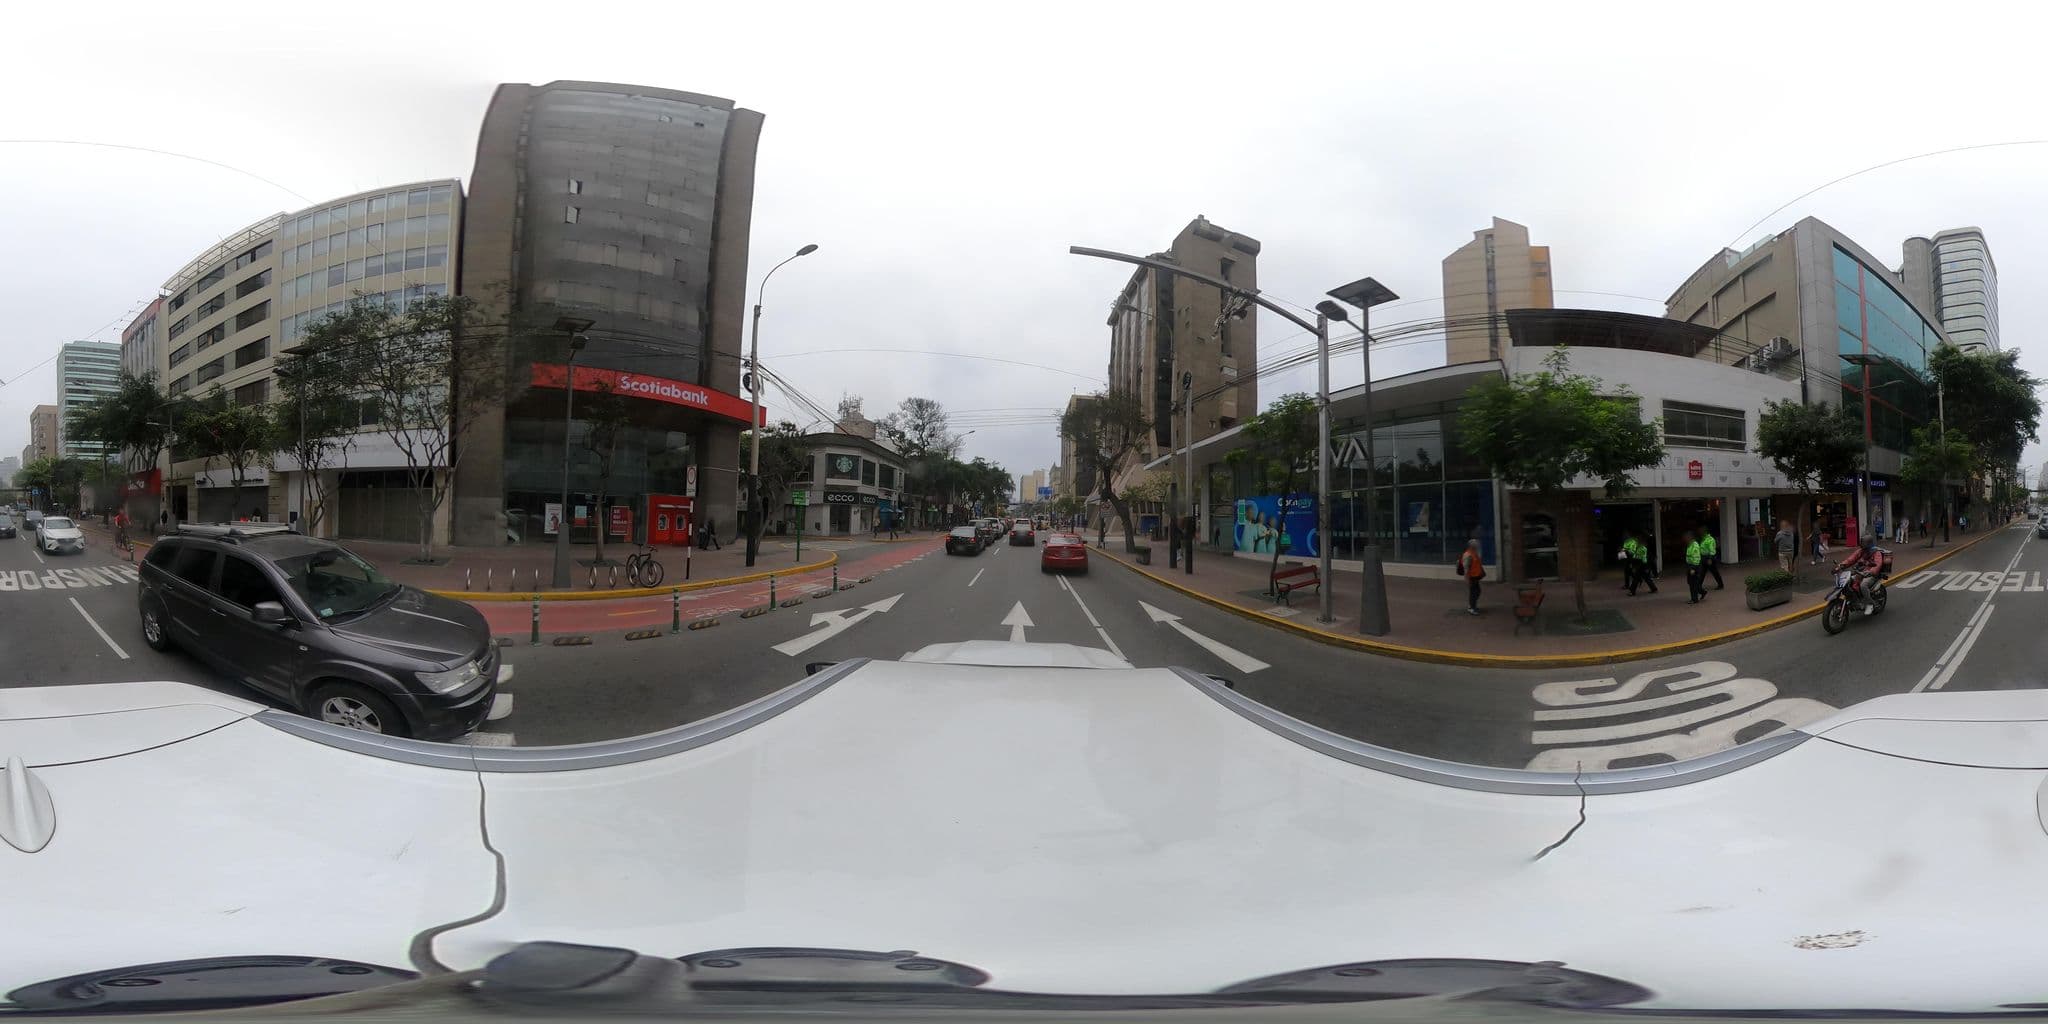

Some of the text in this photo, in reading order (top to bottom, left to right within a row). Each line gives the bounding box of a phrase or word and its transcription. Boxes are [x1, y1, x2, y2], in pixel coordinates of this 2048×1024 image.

[620, 375, 709, 406] Scotiabank
[827, 494, 855, 502] ecco
[862, 496, 876, 504] ecco
[1895, 570, 2001, 592] SOLO
